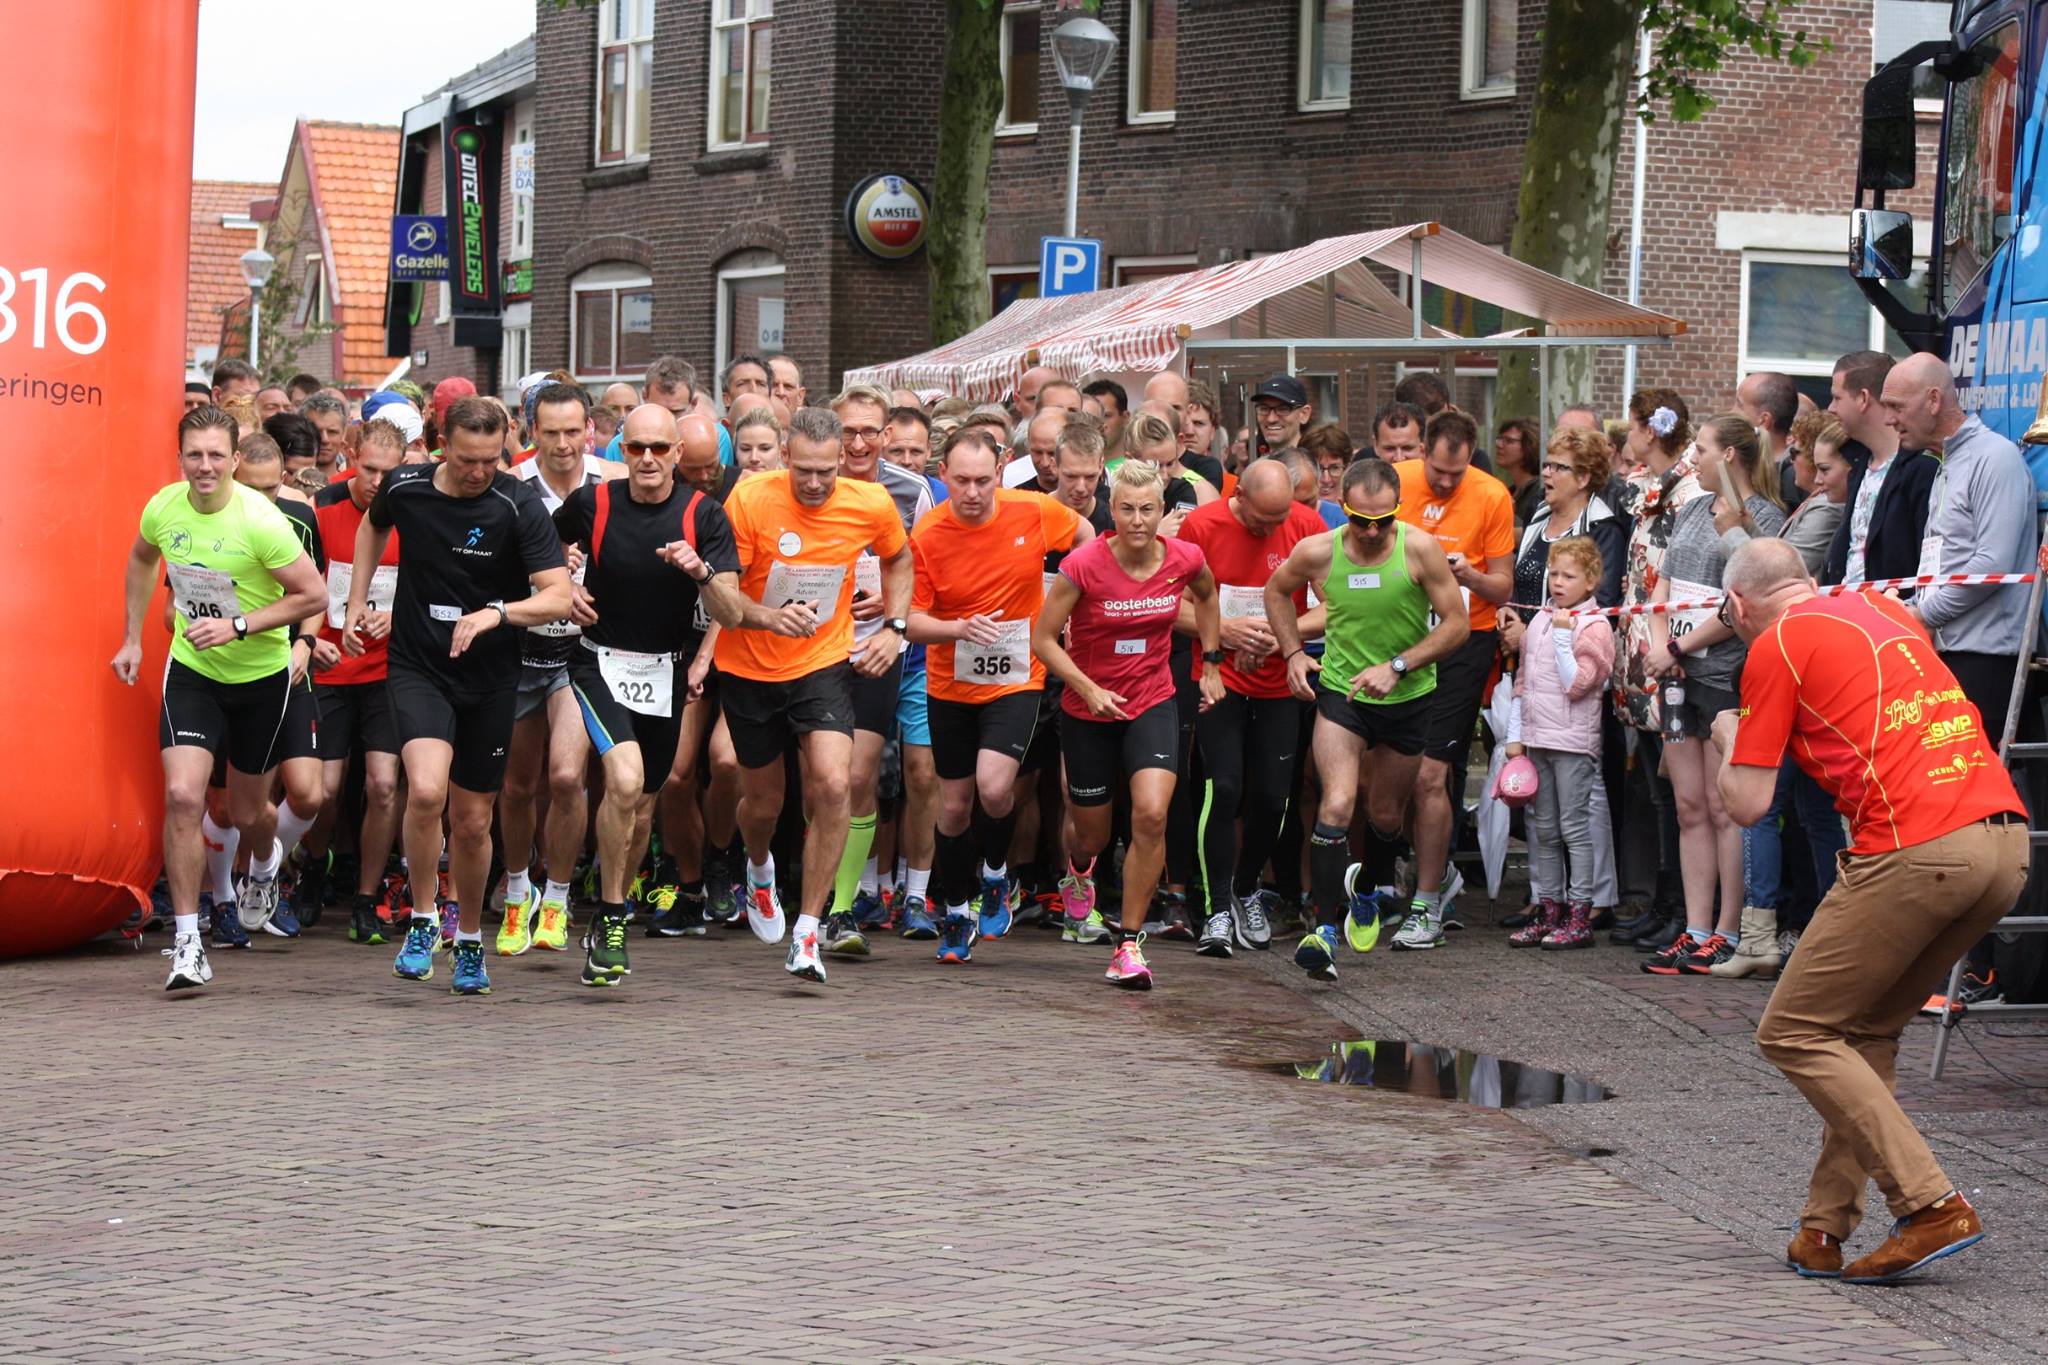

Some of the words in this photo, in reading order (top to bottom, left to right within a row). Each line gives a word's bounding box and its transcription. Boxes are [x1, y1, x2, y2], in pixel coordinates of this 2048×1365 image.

[873, 207, 918, 218] AMSTEL
[396, 253, 449, 268] Gazelle
[1053, 246, 1086, 290] P
[1950, 323, 1980, 378] DE
[2010, 383, 2018, 408] &
[187, 600, 223, 620] 346
[546, 627, 567, 635] TOM
[973, 656, 1011, 675] 356
[618, 681, 655, 703] 322
[1931, 714, 1973, 738] SMP
